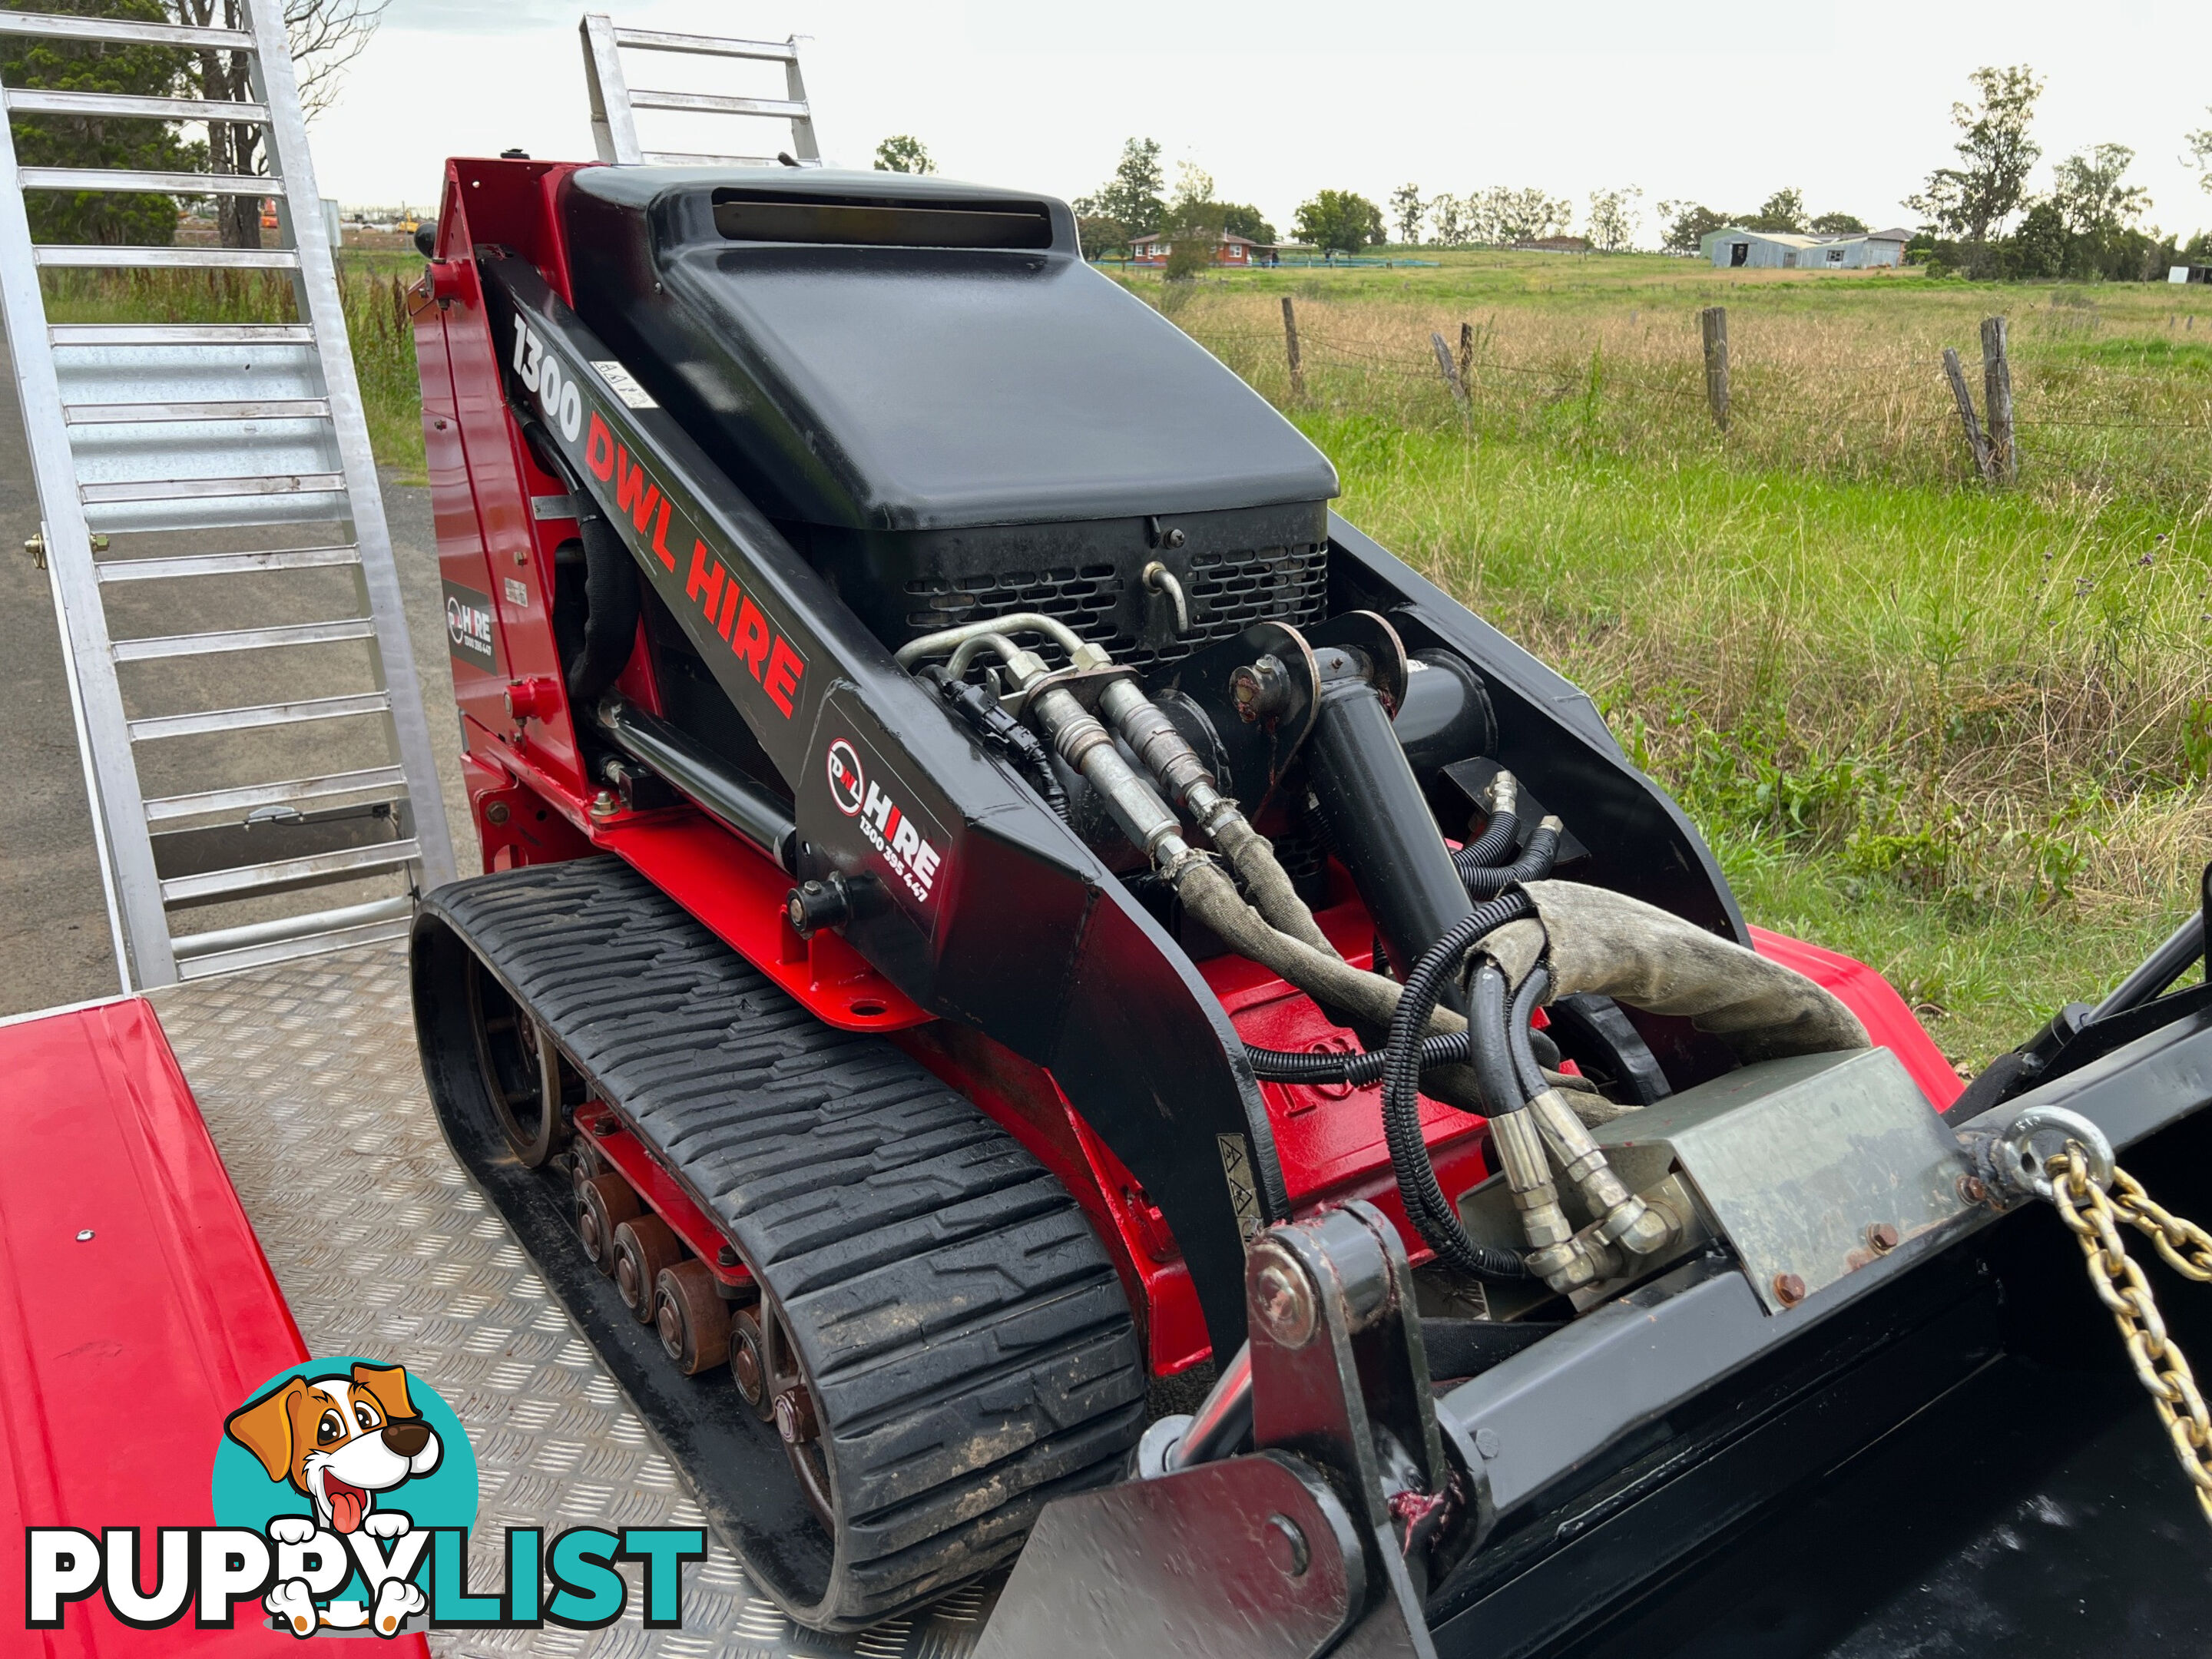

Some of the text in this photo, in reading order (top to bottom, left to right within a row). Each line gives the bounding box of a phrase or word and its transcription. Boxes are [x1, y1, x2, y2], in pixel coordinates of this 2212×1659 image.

[514, 313, 805, 720] 1300 DWL HIRE
[462, 604, 491, 642] HIRE
[859, 815, 928, 902] 1300 395 447
[863, 780, 941, 889] HIRE
